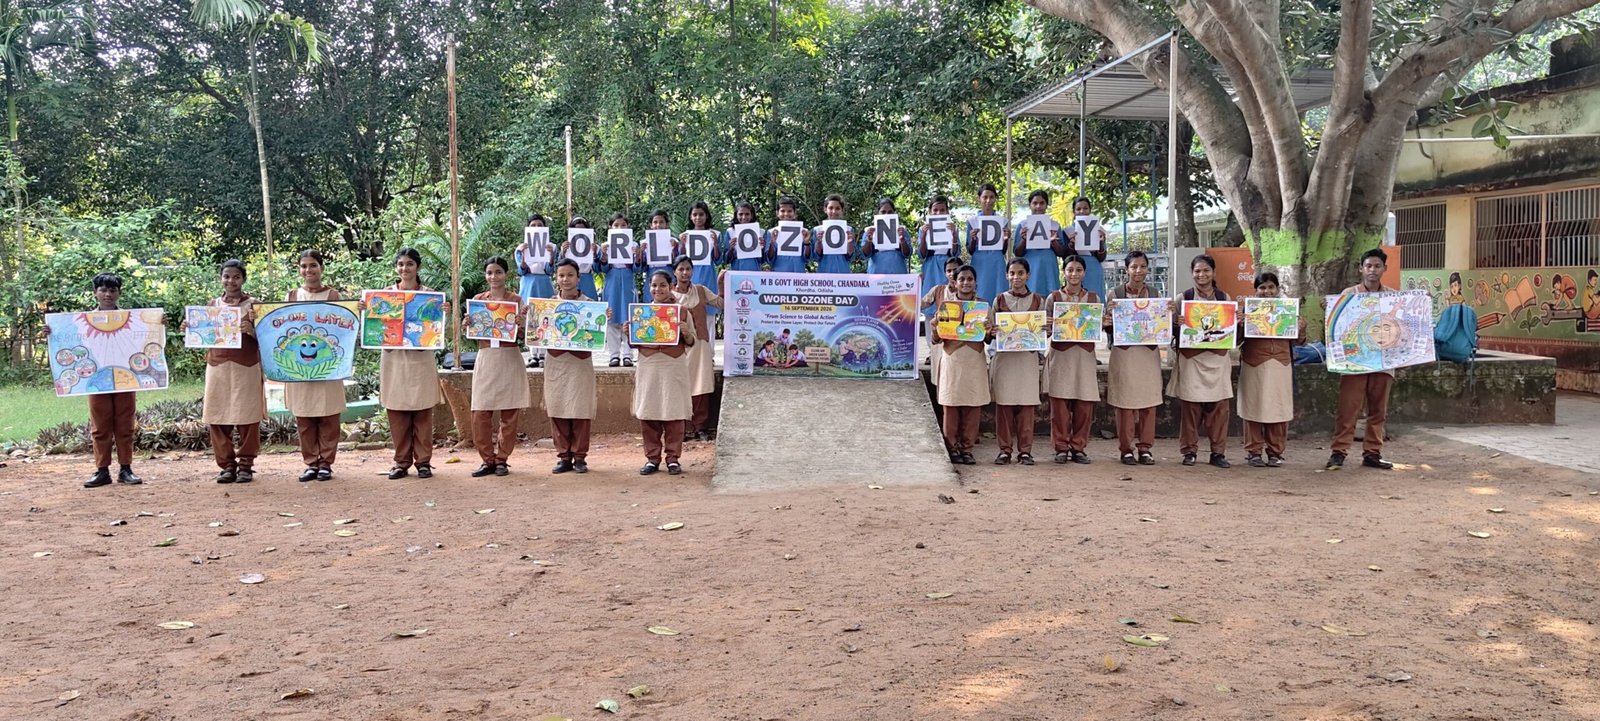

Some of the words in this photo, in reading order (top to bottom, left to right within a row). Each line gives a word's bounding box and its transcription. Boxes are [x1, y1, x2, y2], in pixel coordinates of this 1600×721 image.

[738, 229, 759, 252] O
[780, 226, 801, 252] Z
[825, 228, 846, 249] O
[877, 219, 896, 245] N
[929, 218, 949, 245] E
[981, 220, 1001, 246] D
[1030, 220, 1049, 241] A
[1077, 220, 1099, 247] Y
[527, 232, 548, 257] W
[570, 233, 591, 257] O
[611, 233, 630, 259] R
[649, 233, 669, 262] L
[689, 234, 710, 261] D
[760, 278, 767, 286] M
[775, 279, 792, 287] GOVT
[793, 279, 809, 287] HIGH
[810, 279, 837, 288] SCHOOL,
[837, 280, 870, 288] CHANDAKA
[763, 295, 798, 304] WORLD
[801, 296, 833, 304] OZONE
[835, 296, 854, 305] DAY
